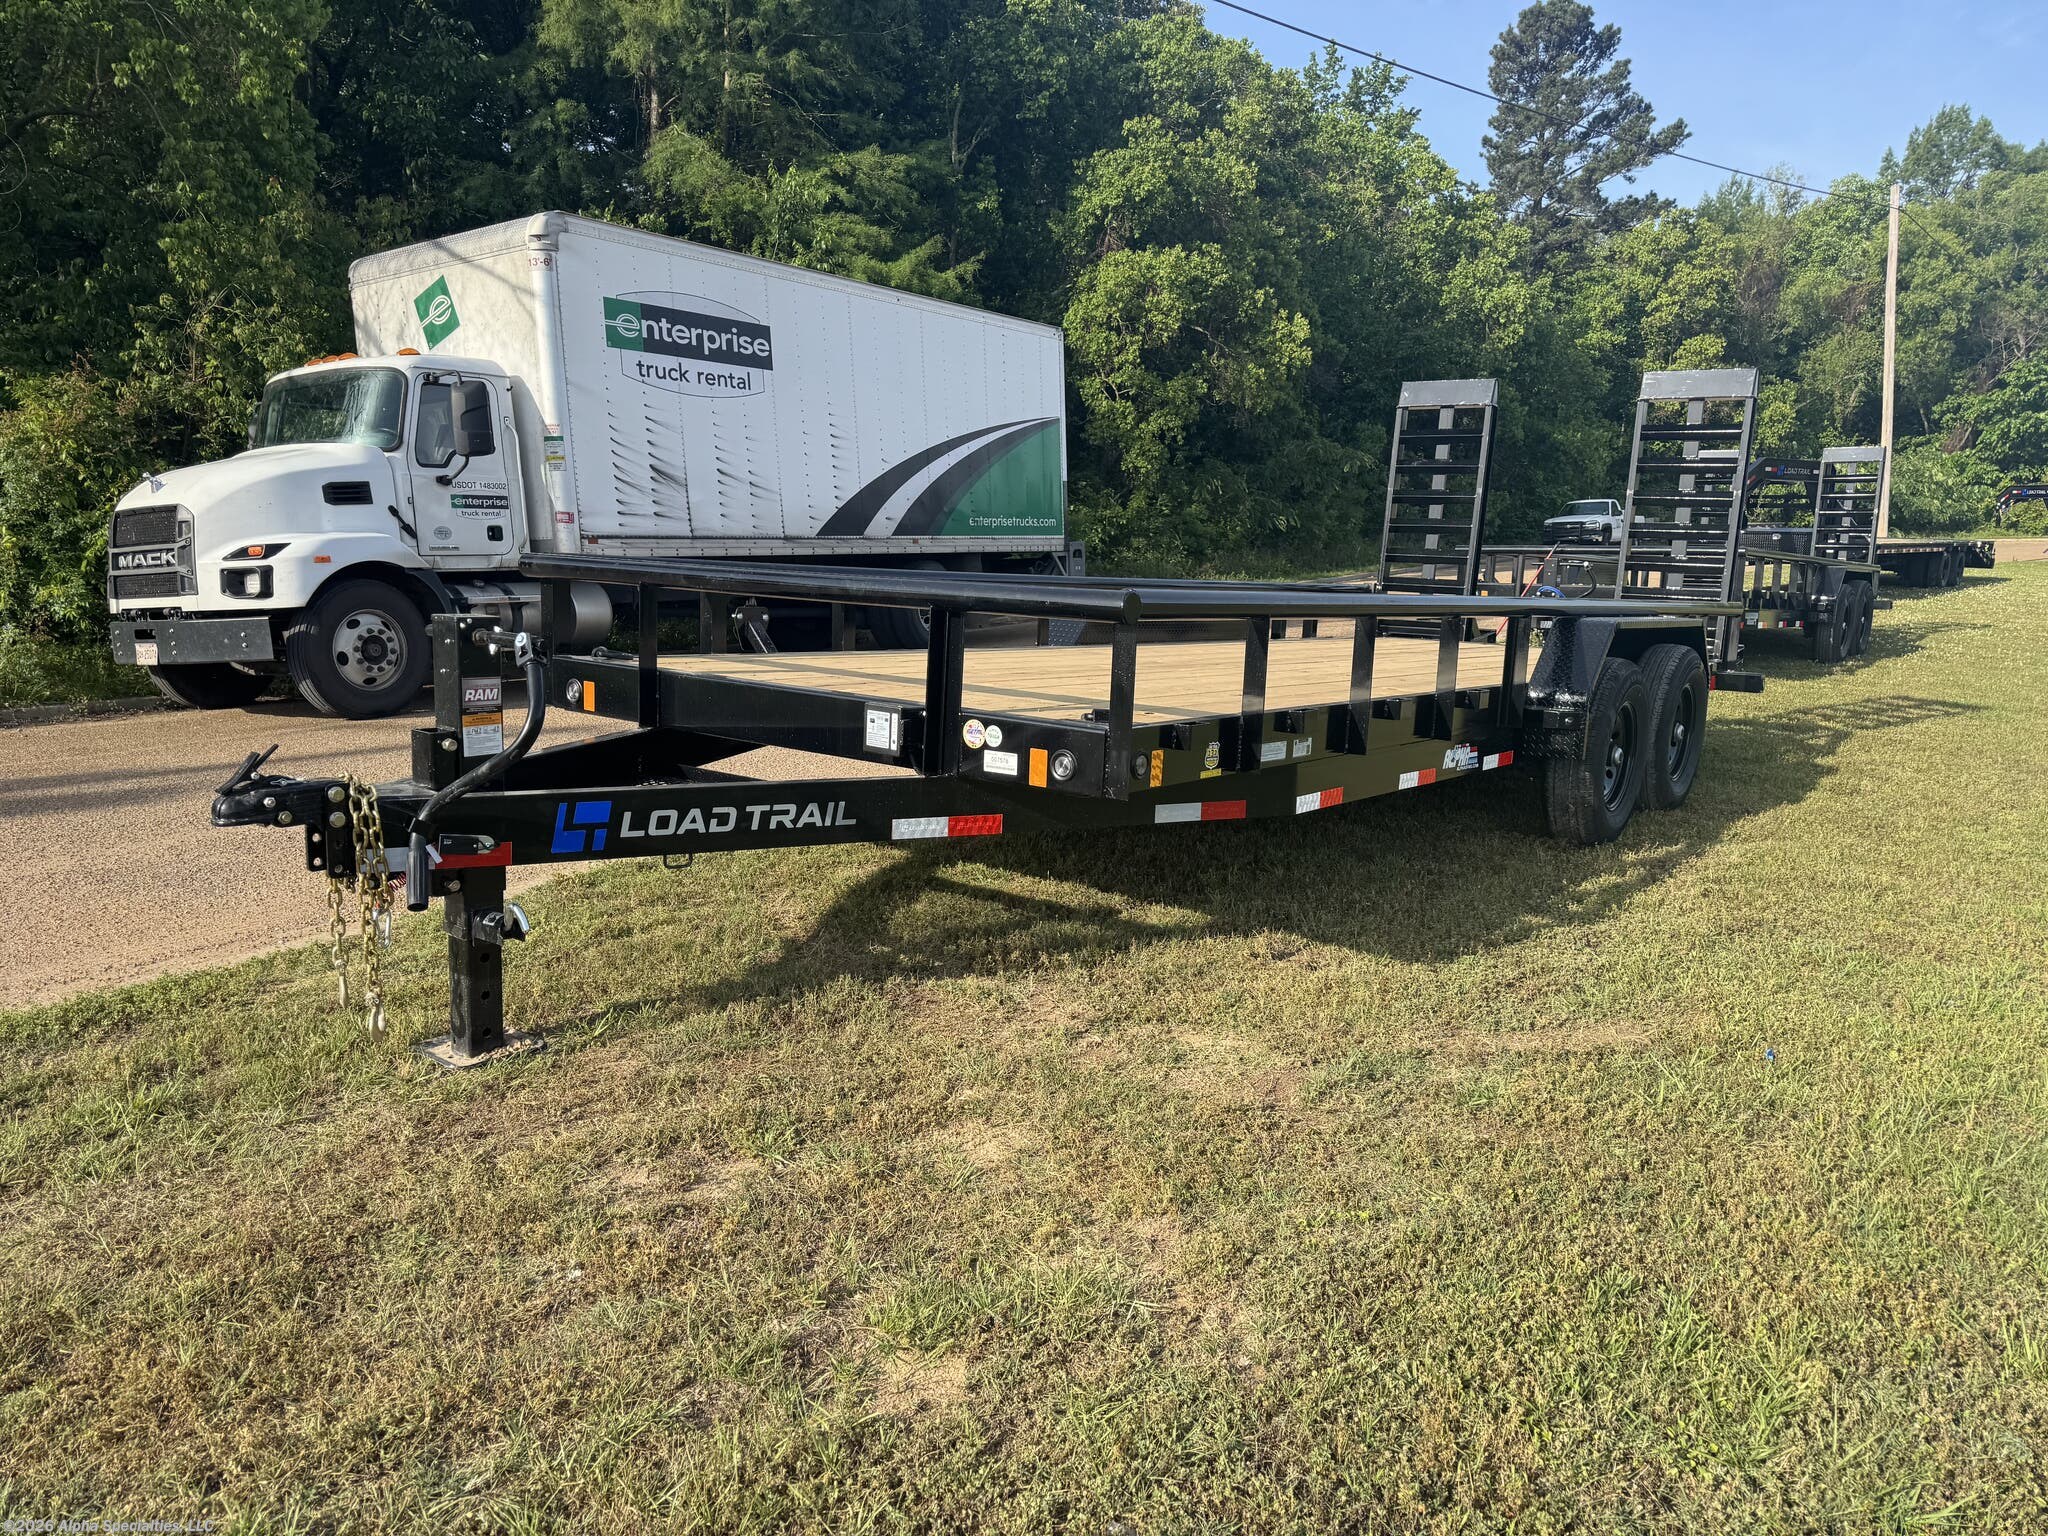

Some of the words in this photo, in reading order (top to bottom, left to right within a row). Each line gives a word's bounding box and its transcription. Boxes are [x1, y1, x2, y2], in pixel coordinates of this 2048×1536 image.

[605, 313, 770, 357] enterprise
[636, 360, 690, 383] truck
[697, 370, 751, 390] rental
[452, 481, 476, 489] USDOT
[480, 482, 507, 490] 1483002
[452, 497, 508, 507] enterprise
[969, 515, 1056, 529] enterprisetrucks.com
[118, 551, 176, 568] MACK
[464, 688, 499, 702] RAM
[619, 806, 738, 838] LOAD
[745, 801, 857, 830] TRAIL
